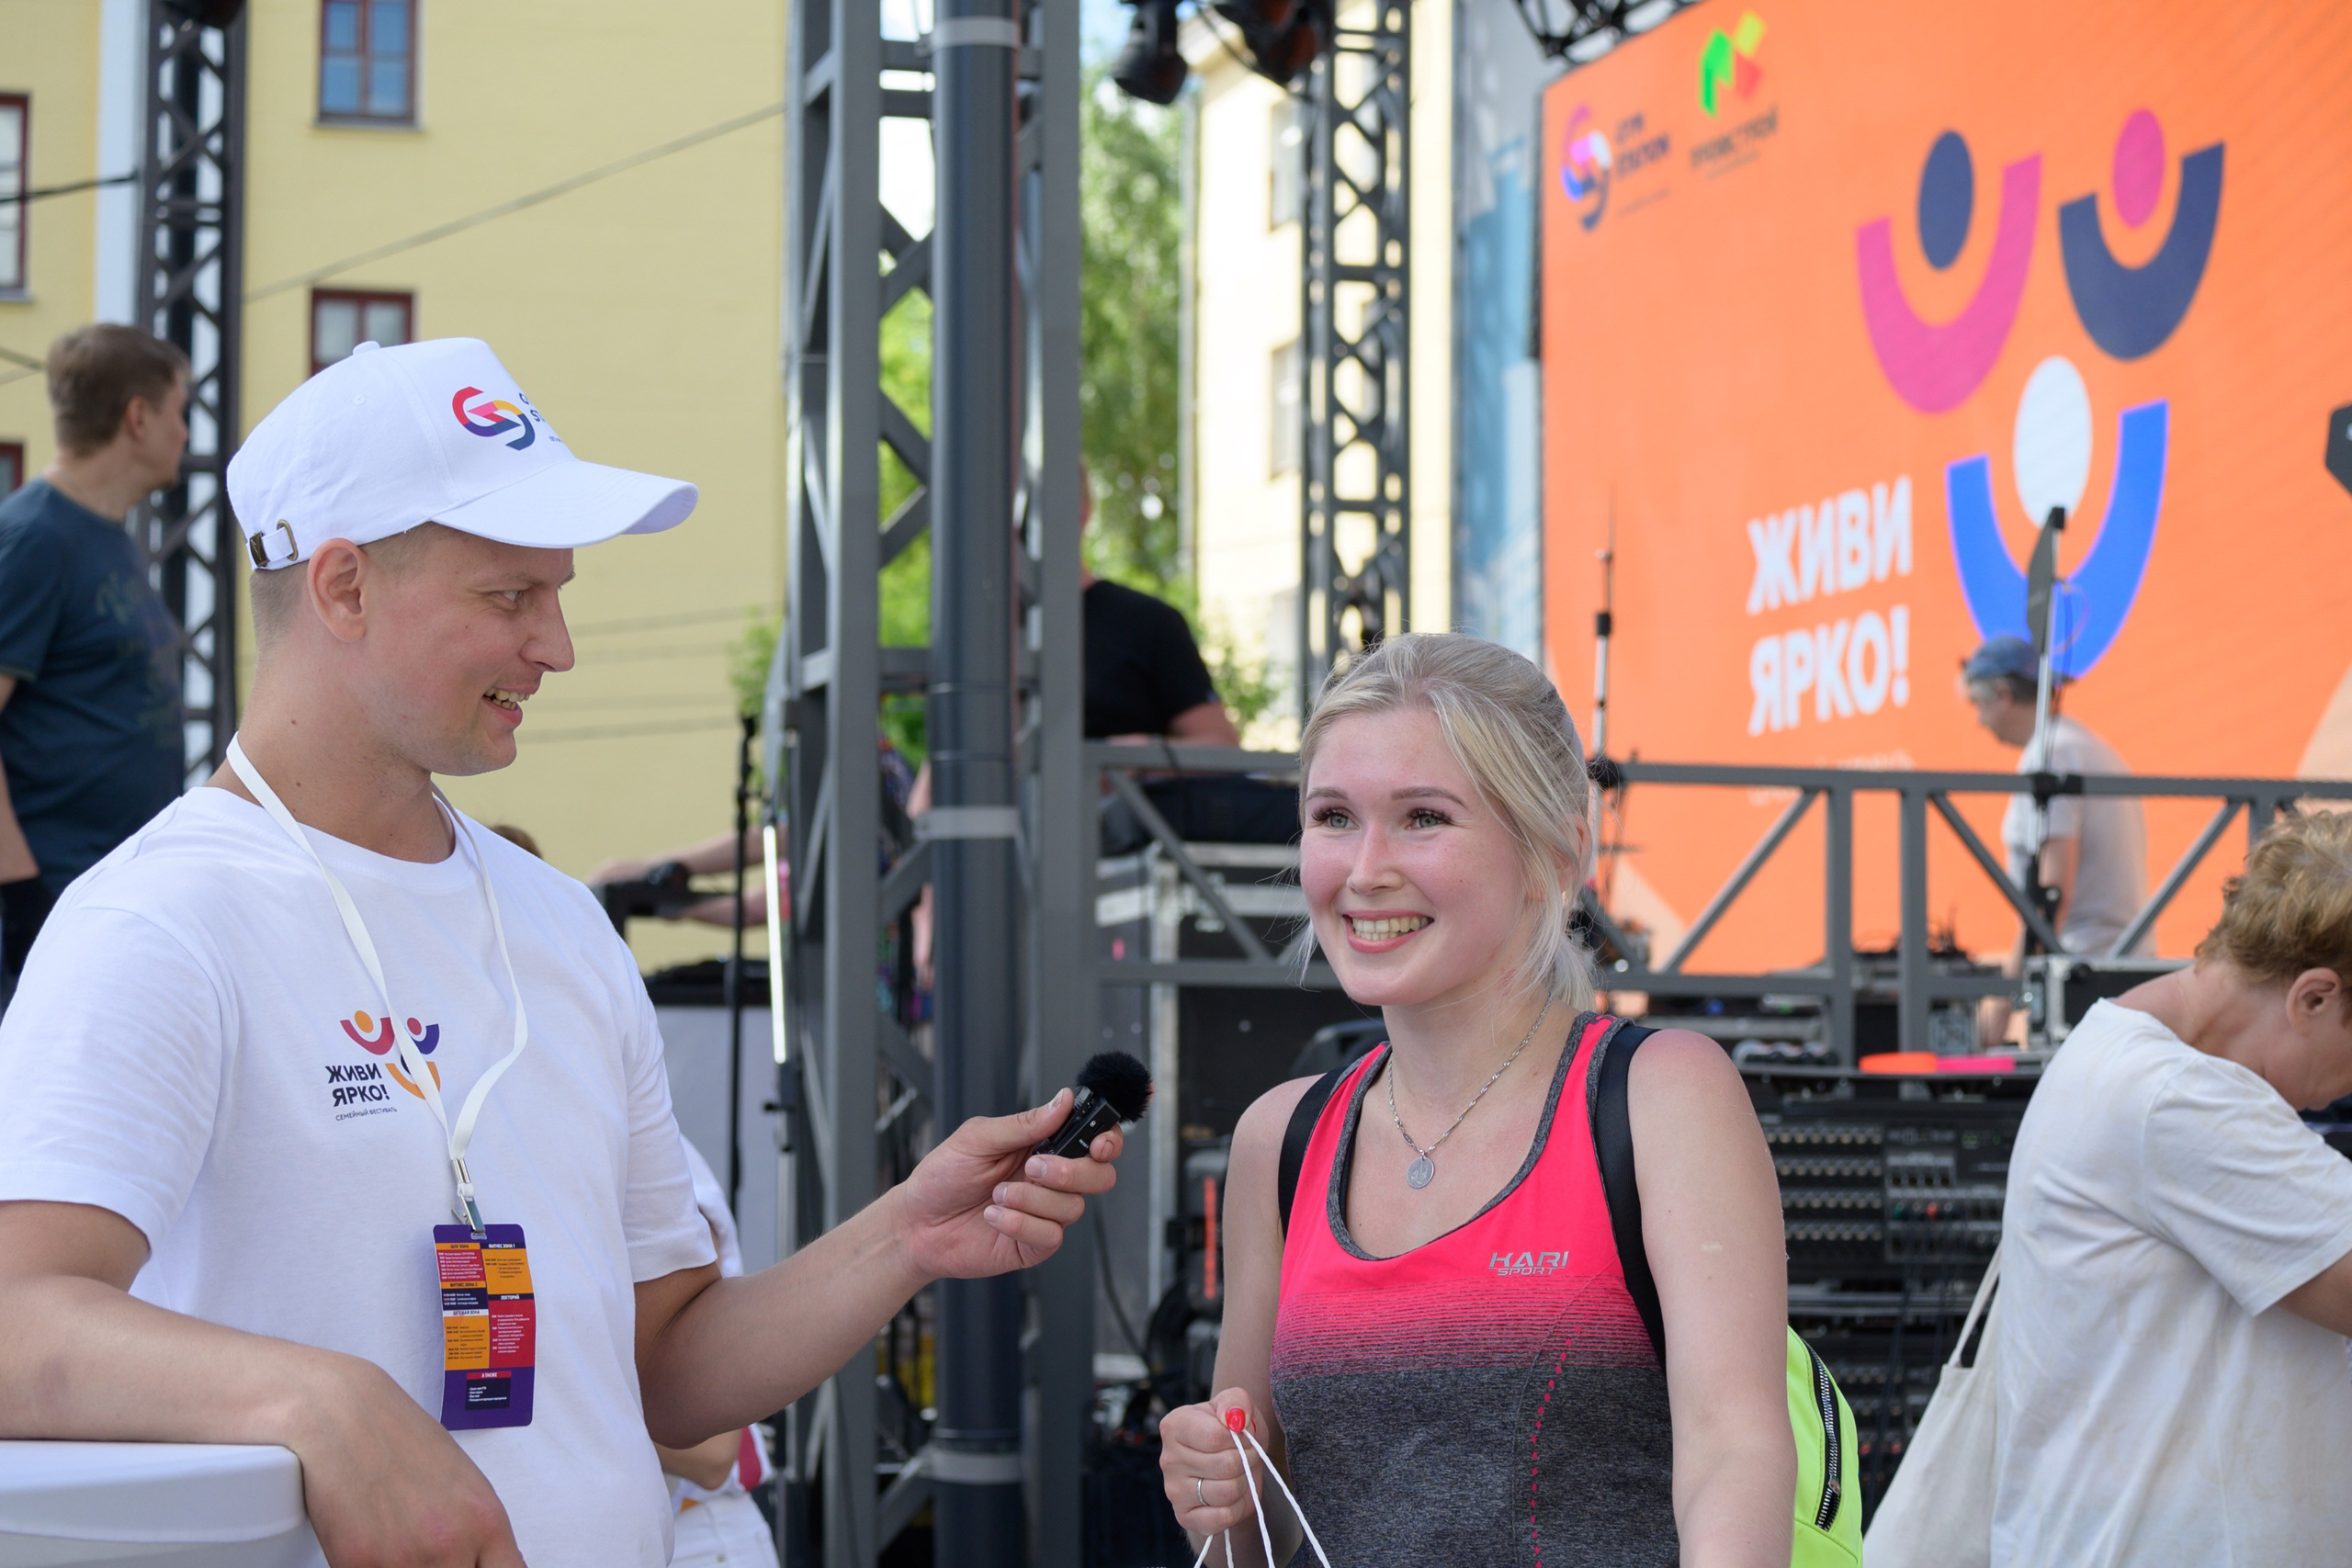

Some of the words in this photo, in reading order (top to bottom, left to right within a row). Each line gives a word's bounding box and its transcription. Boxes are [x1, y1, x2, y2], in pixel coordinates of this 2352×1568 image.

[1746, 474, 1913, 616] ЖИВИ
[1748, 605, 1910, 736] ЯРКО!
[325, 1063, 382, 1084] ЖИВИ
[332, 1084, 390, 1108] ЯРКО!
[335, 1110, 368, 1121] СЕМЕЙНЫЙ
[1488, 1250, 1569, 1268] KARI
[1498, 1268, 1555, 1276] SPORT
